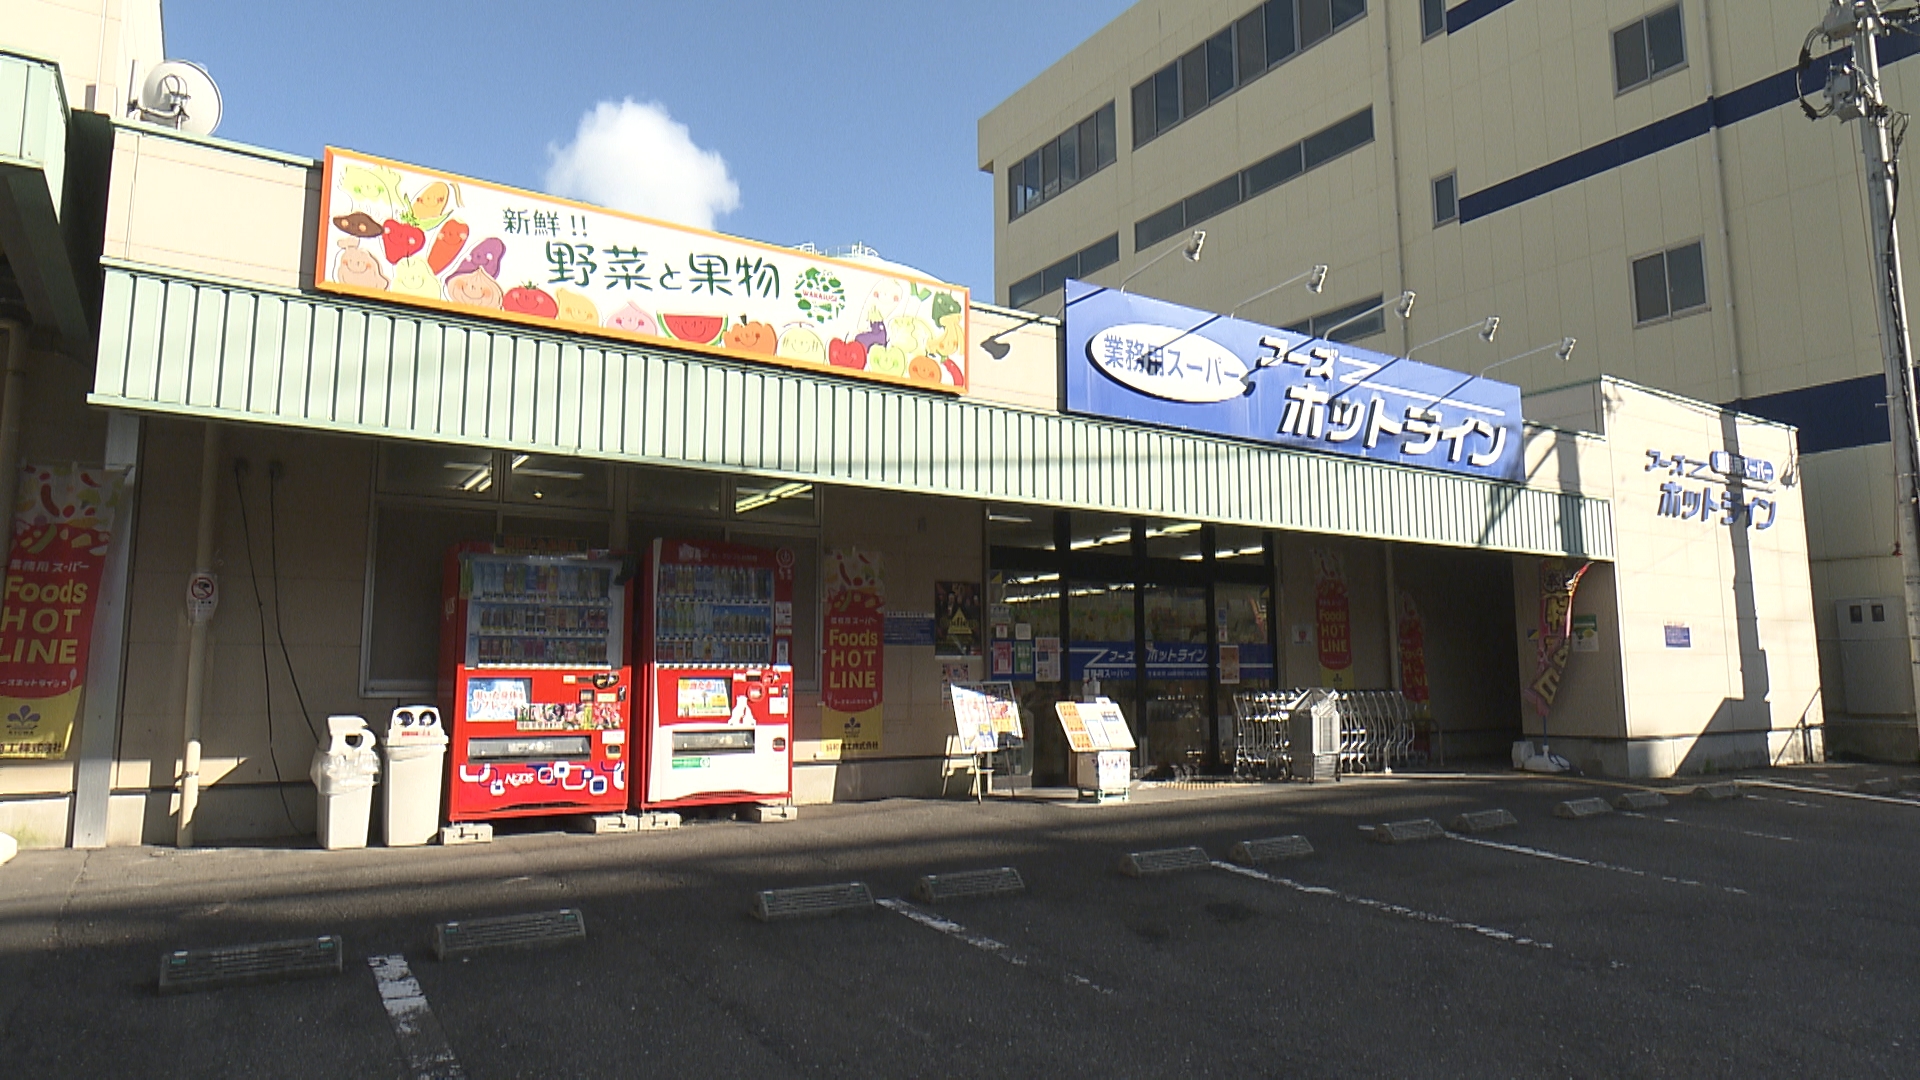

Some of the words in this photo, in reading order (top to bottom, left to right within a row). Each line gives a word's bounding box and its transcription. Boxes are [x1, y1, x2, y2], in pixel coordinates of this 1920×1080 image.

[545, 241, 780, 300] 野菜と果物
[1103, 333, 1242, 386] 業務用スーパー
[1257, 335, 1339, 382] フーズ
[1279, 384, 1507, 466] ホットライン
[1657, 480, 1777, 530] ホットライン
[4, 574, 89, 605] Foods
[0, 607, 81, 634] HOT
[1321, 624, 1346, 639] HOT
[0, 637, 78, 665] LINE
[828, 628, 879, 648] Foods
[1321, 638, 1348, 653] LINE
[830, 649, 877, 669] HOT
[829, 670, 877, 689] LINE
